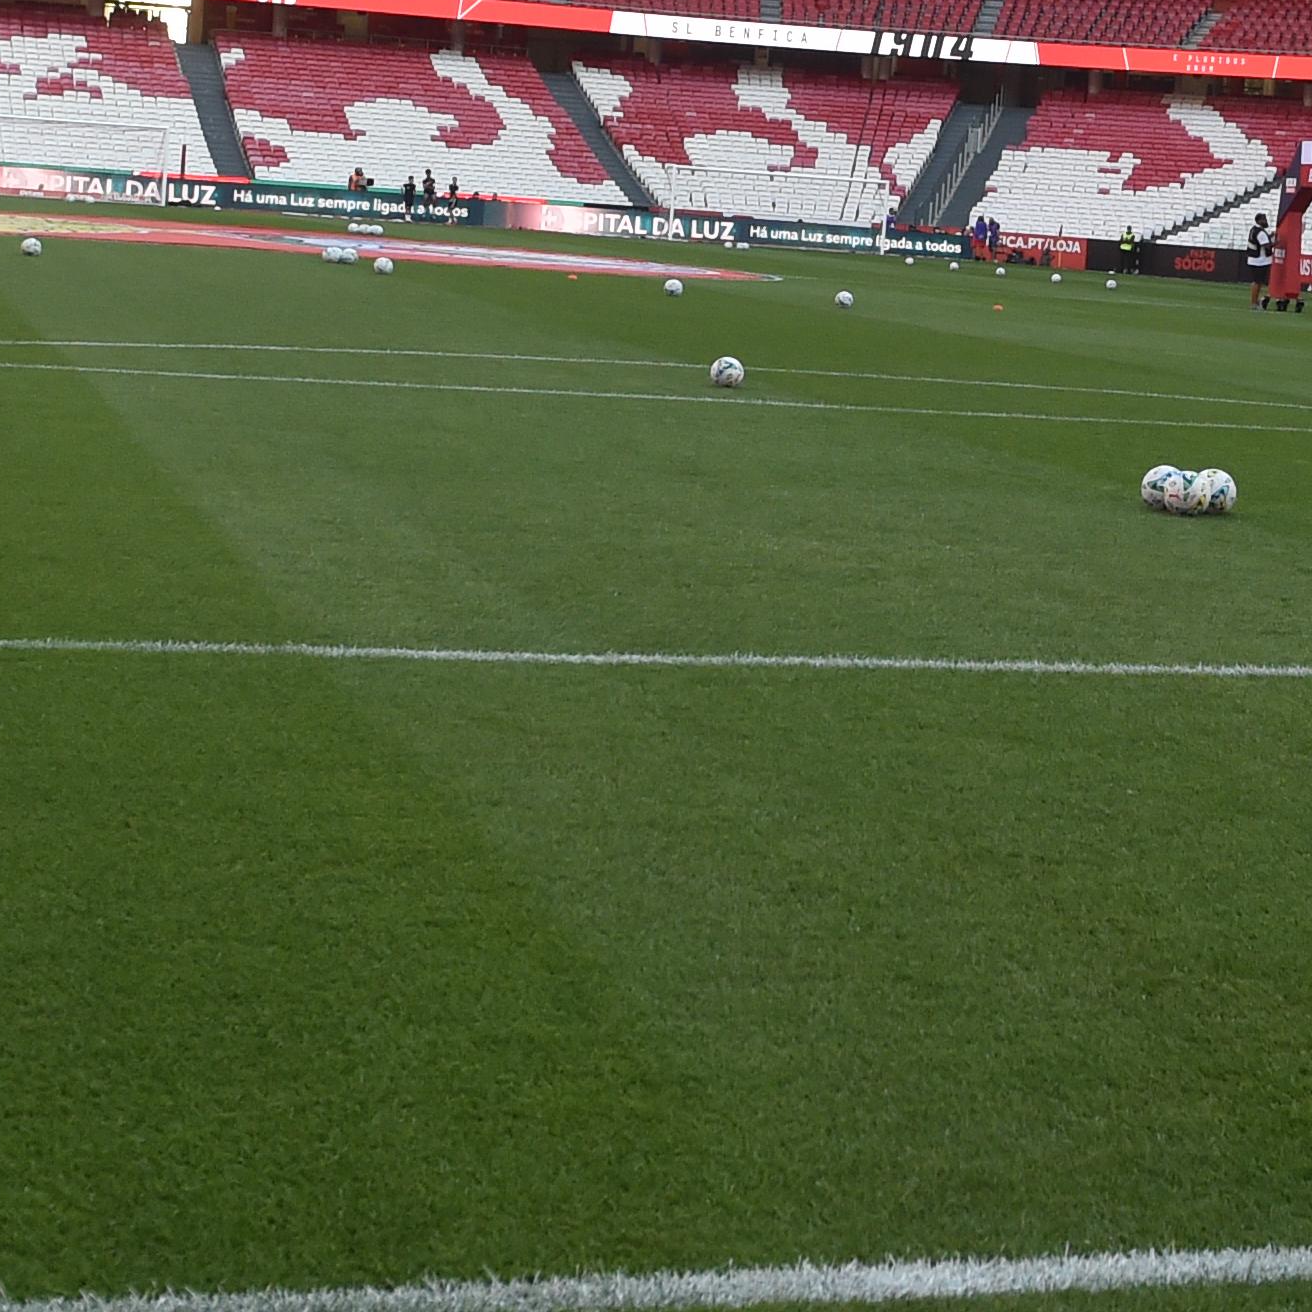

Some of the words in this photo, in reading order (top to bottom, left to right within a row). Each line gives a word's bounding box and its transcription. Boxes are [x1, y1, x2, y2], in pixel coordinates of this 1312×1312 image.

[672, 21, 692, 35] SL
[715, 24, 808, 44] BENFICA
[125, 178, 162, 200] DA
[168, 181, 216, 206] LUZ
[233, 191, 254, 205] Há
[257, 194, 287, 207] uma
[290, 194, 314, 209] Luz
[317, 197, 370, 214] sempre
[373, 198, 414, 215] ligad
[652, 217, 685, 237] DA
[691, 219, 735, 241] LUZ
[750, 224, 768, 238] Há
[770, 228, 799, 242] uma
[801, 229, 824, 244] Luz
[826, 233, 873, 250] sempre
[915, 240, 923, 251] a
[925, 239, 962, 254] todos
